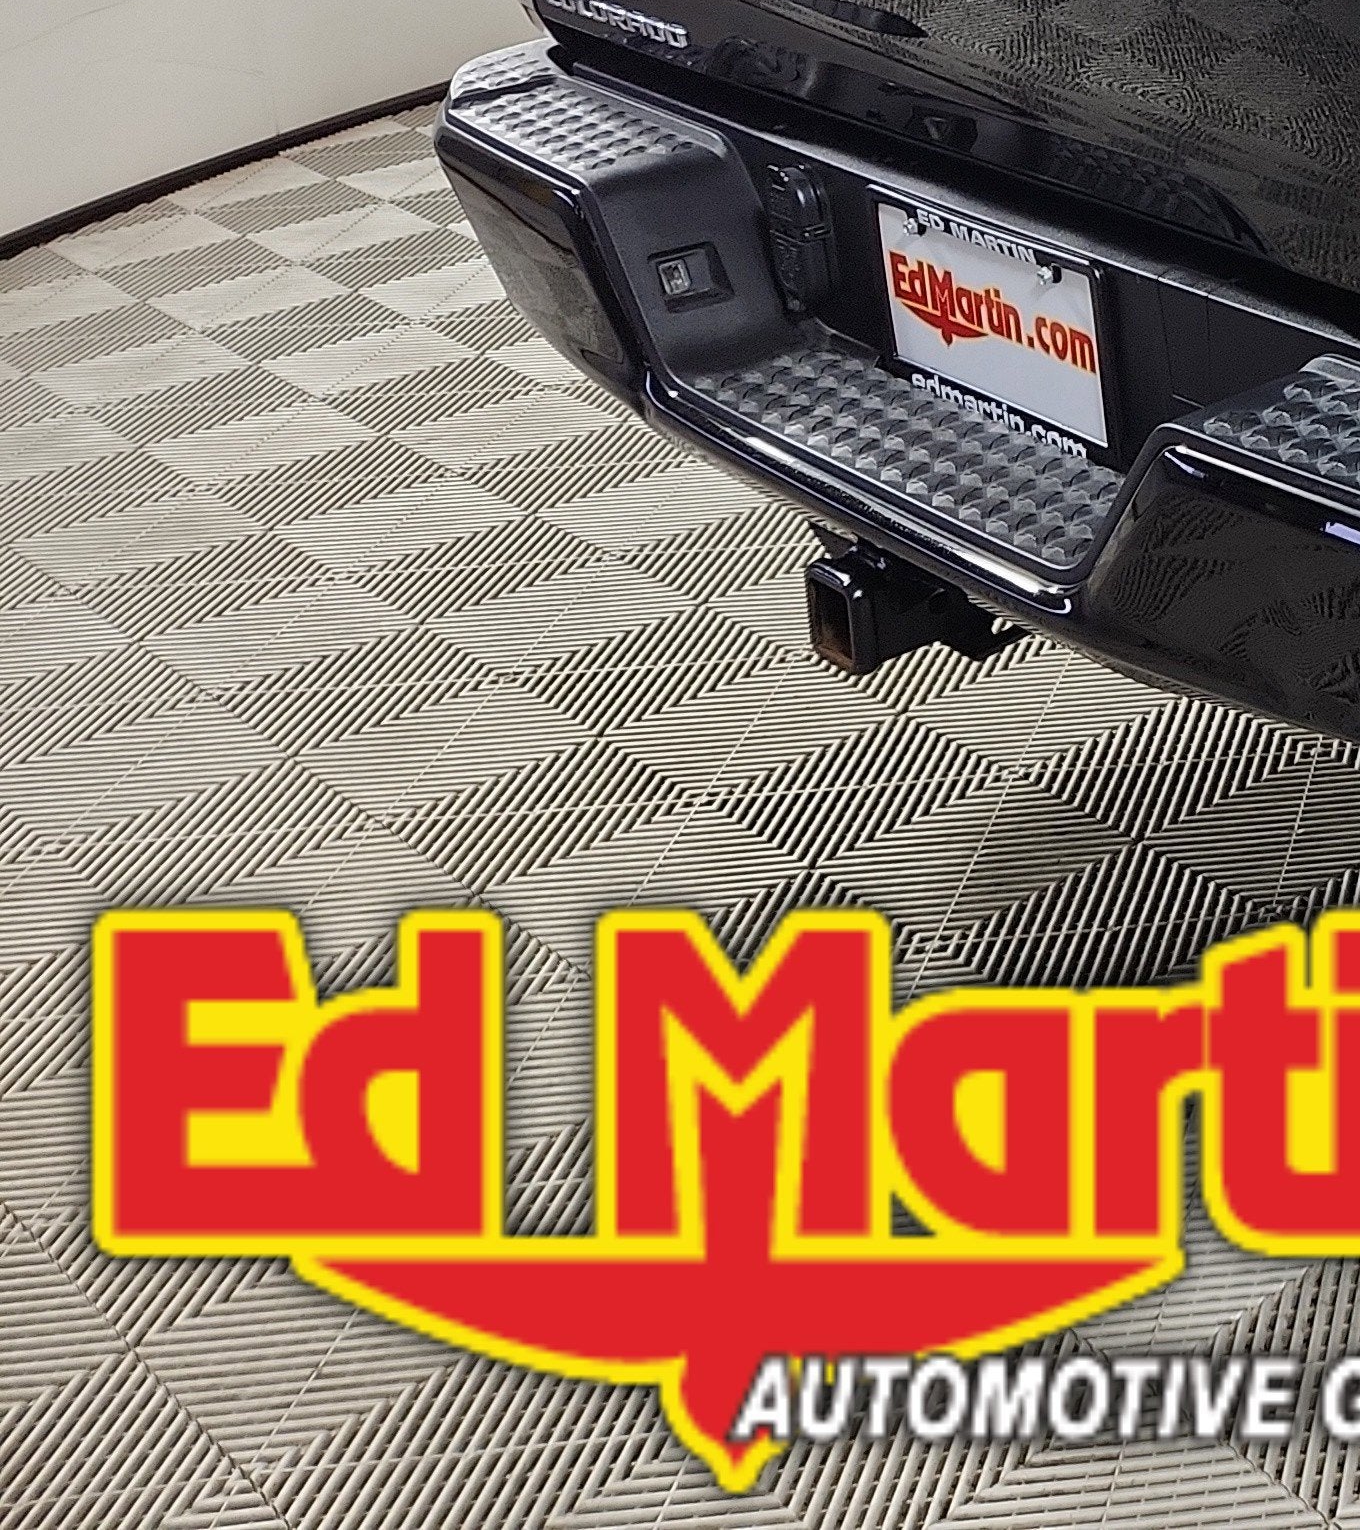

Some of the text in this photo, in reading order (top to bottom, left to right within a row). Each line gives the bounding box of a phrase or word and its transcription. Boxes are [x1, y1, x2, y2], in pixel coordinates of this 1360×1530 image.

[917, 209, 1035, 263] ED MARTIN
[911, 374, 1087, 459] edmartin.com
